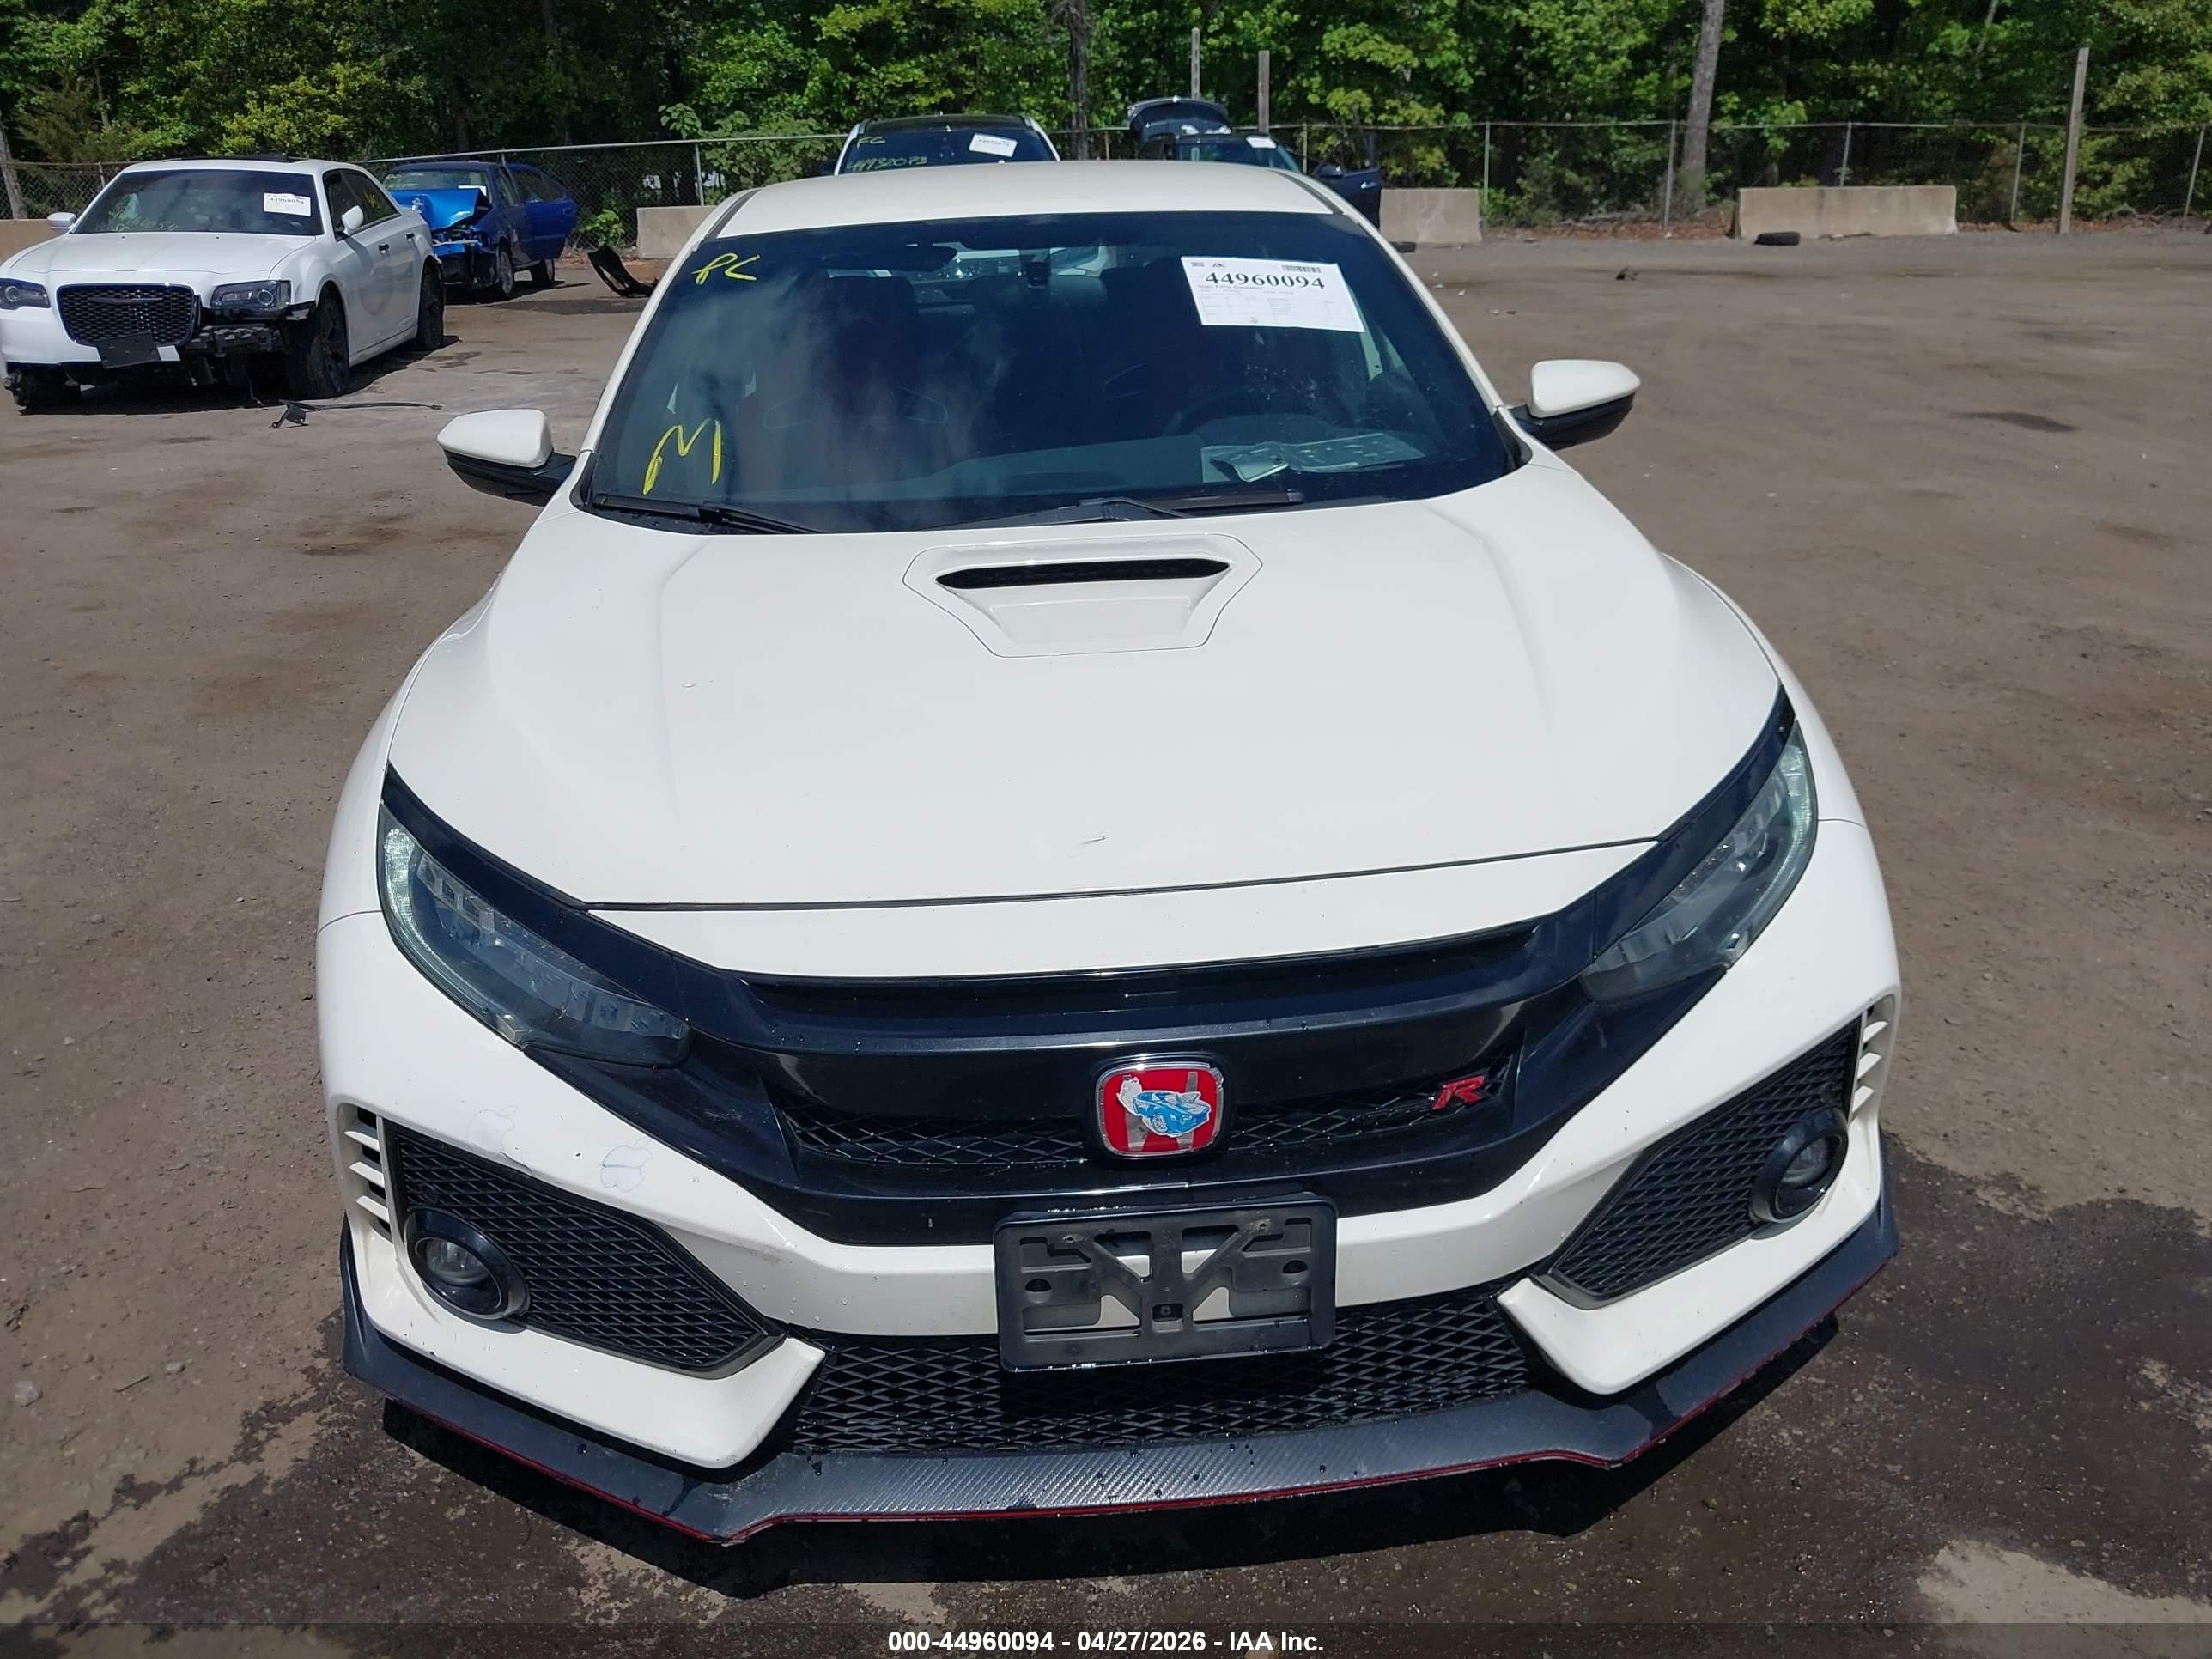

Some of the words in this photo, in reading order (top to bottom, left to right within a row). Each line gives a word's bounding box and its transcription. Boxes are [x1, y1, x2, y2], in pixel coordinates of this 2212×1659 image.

[1205, 271, 1327, 290] 44960094
[641, 417, 722, 495] M
[1432, 1075, 1485, 1111] R
